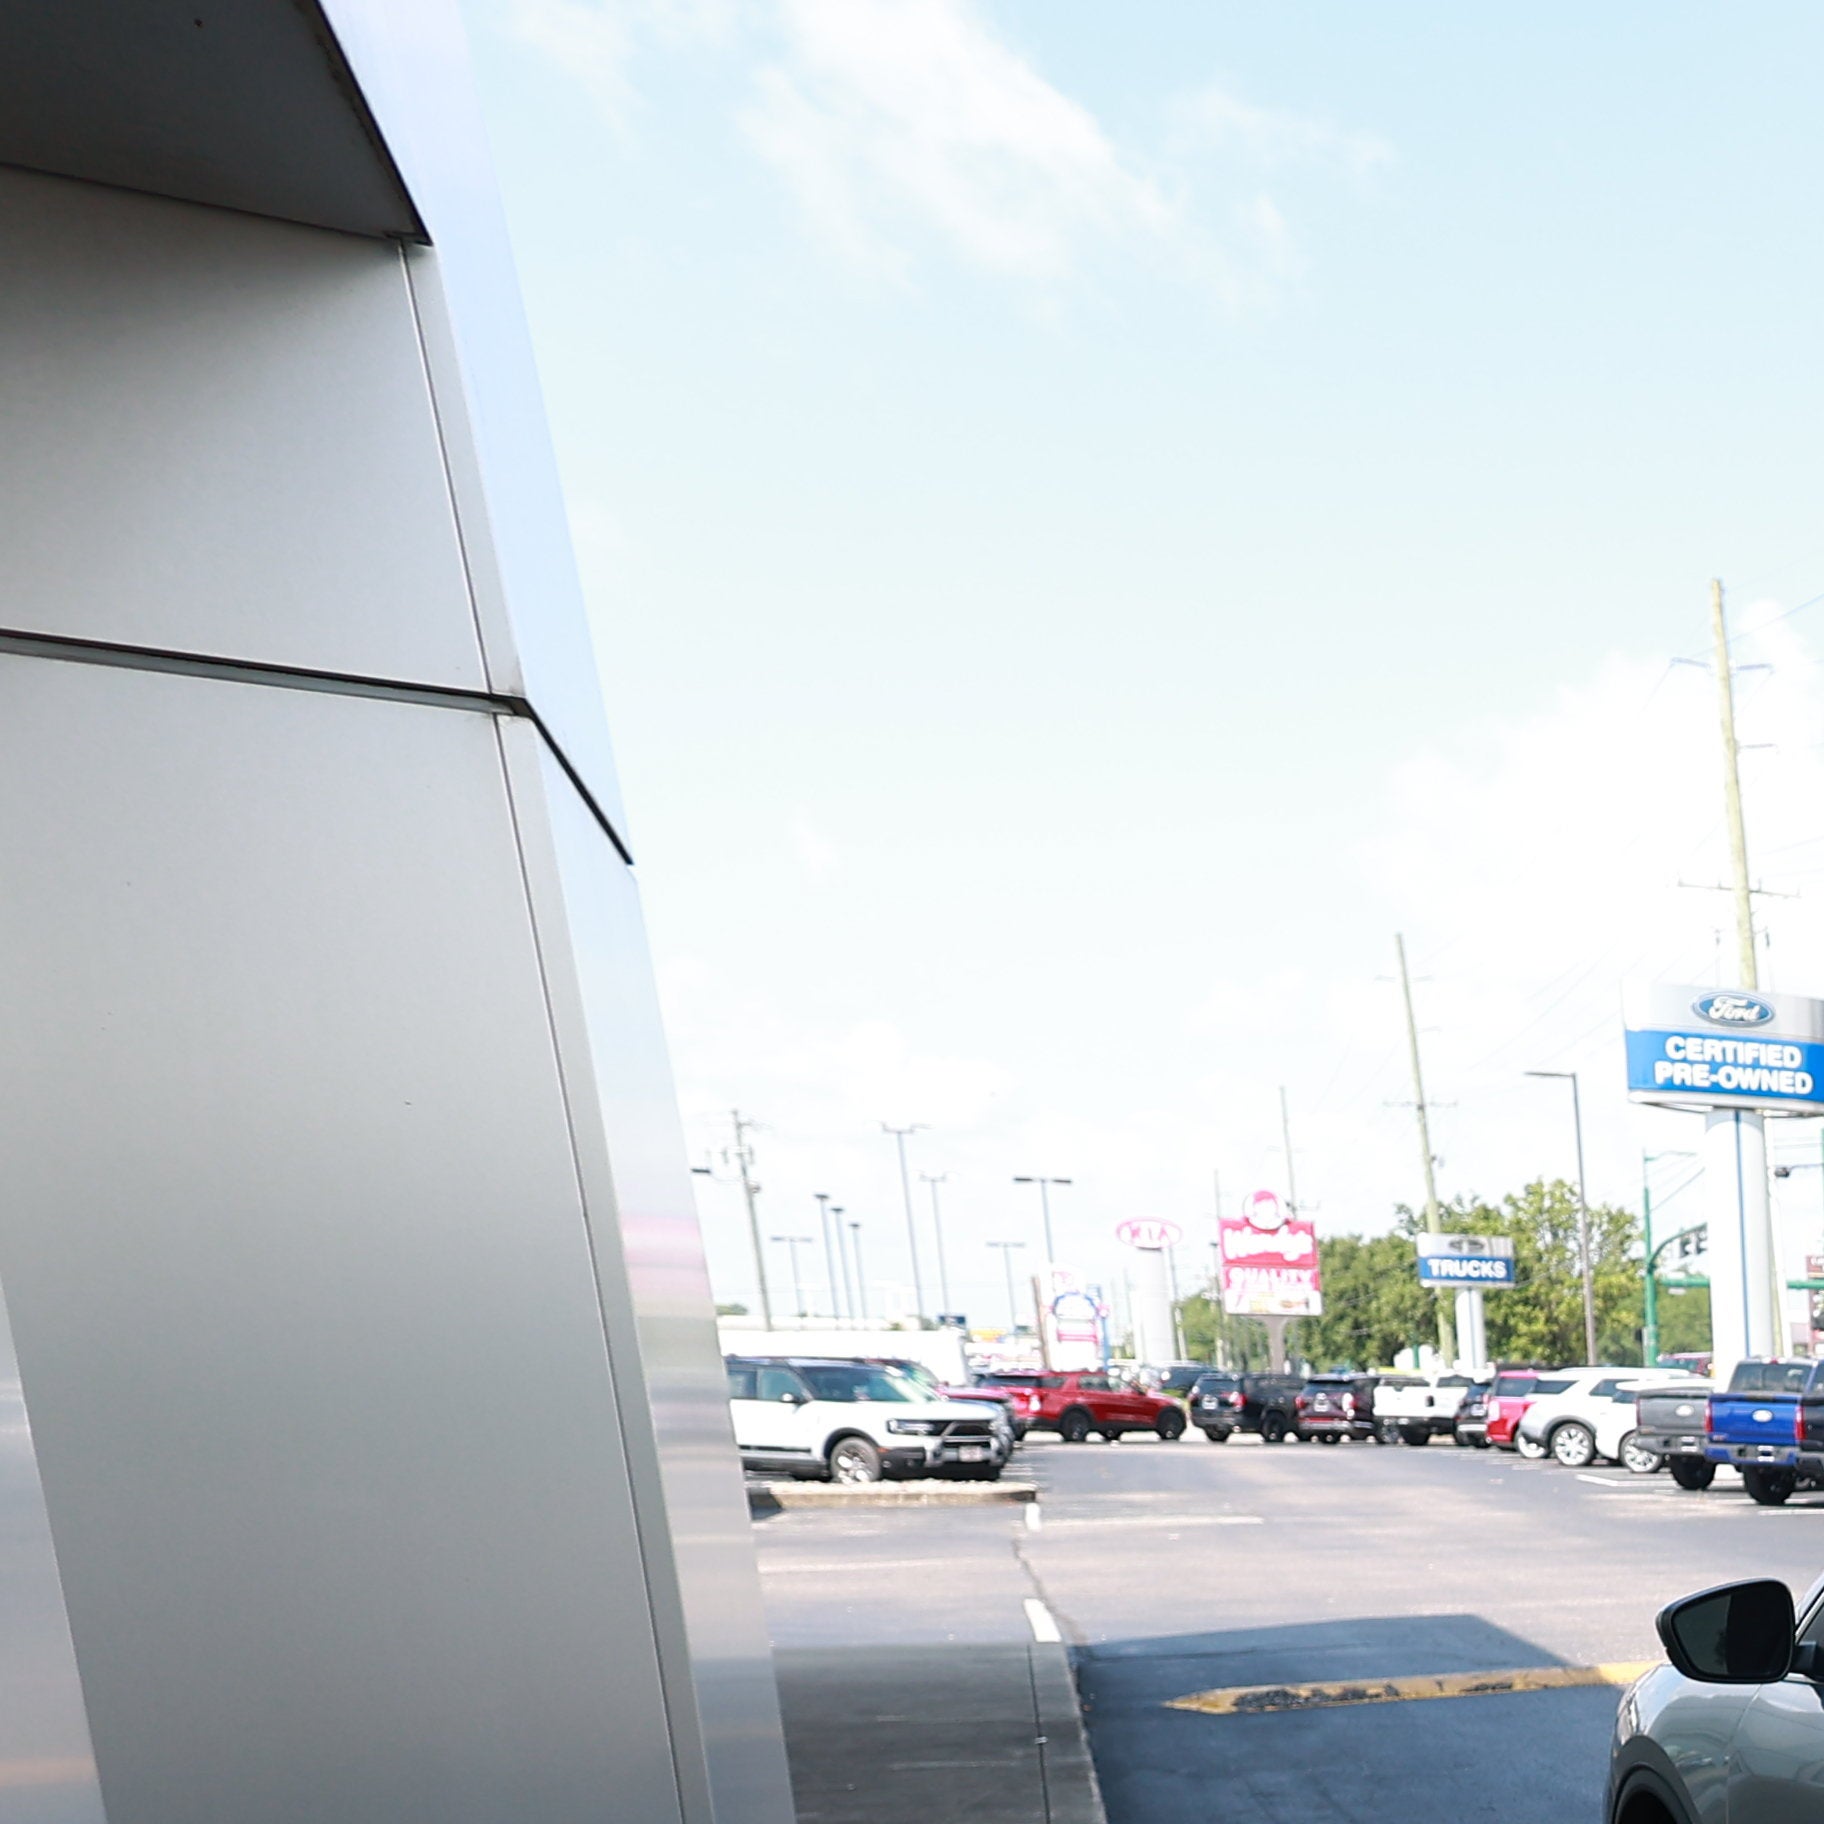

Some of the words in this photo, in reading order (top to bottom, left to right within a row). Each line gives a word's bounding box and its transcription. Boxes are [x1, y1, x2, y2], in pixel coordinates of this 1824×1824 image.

[1708, 995, 1760, 1022] Ford
[1664, 1034, 1803, 1069] CERTIFIED
[1653, 1060, 1814, 1095] PRE-OWNED
[1427, 1258, 1508, 1279] TRUCKS
